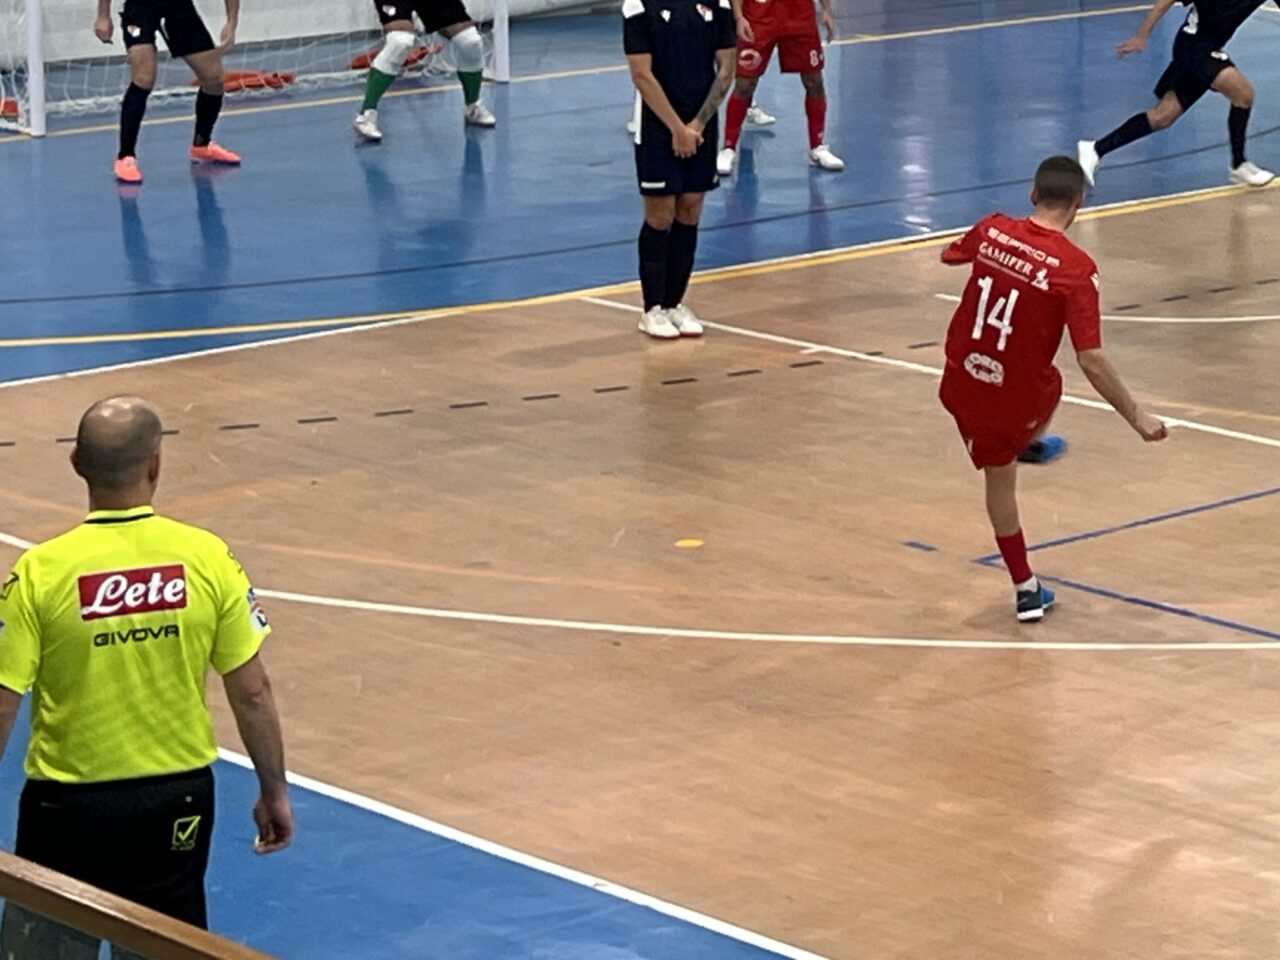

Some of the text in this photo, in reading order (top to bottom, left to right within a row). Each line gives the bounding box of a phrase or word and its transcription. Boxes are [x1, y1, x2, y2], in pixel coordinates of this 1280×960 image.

[971, 275, 1020, 352] 14
[80, 572, 185, 614] Lete
[93, 624, 180, 647] GIVOVA
